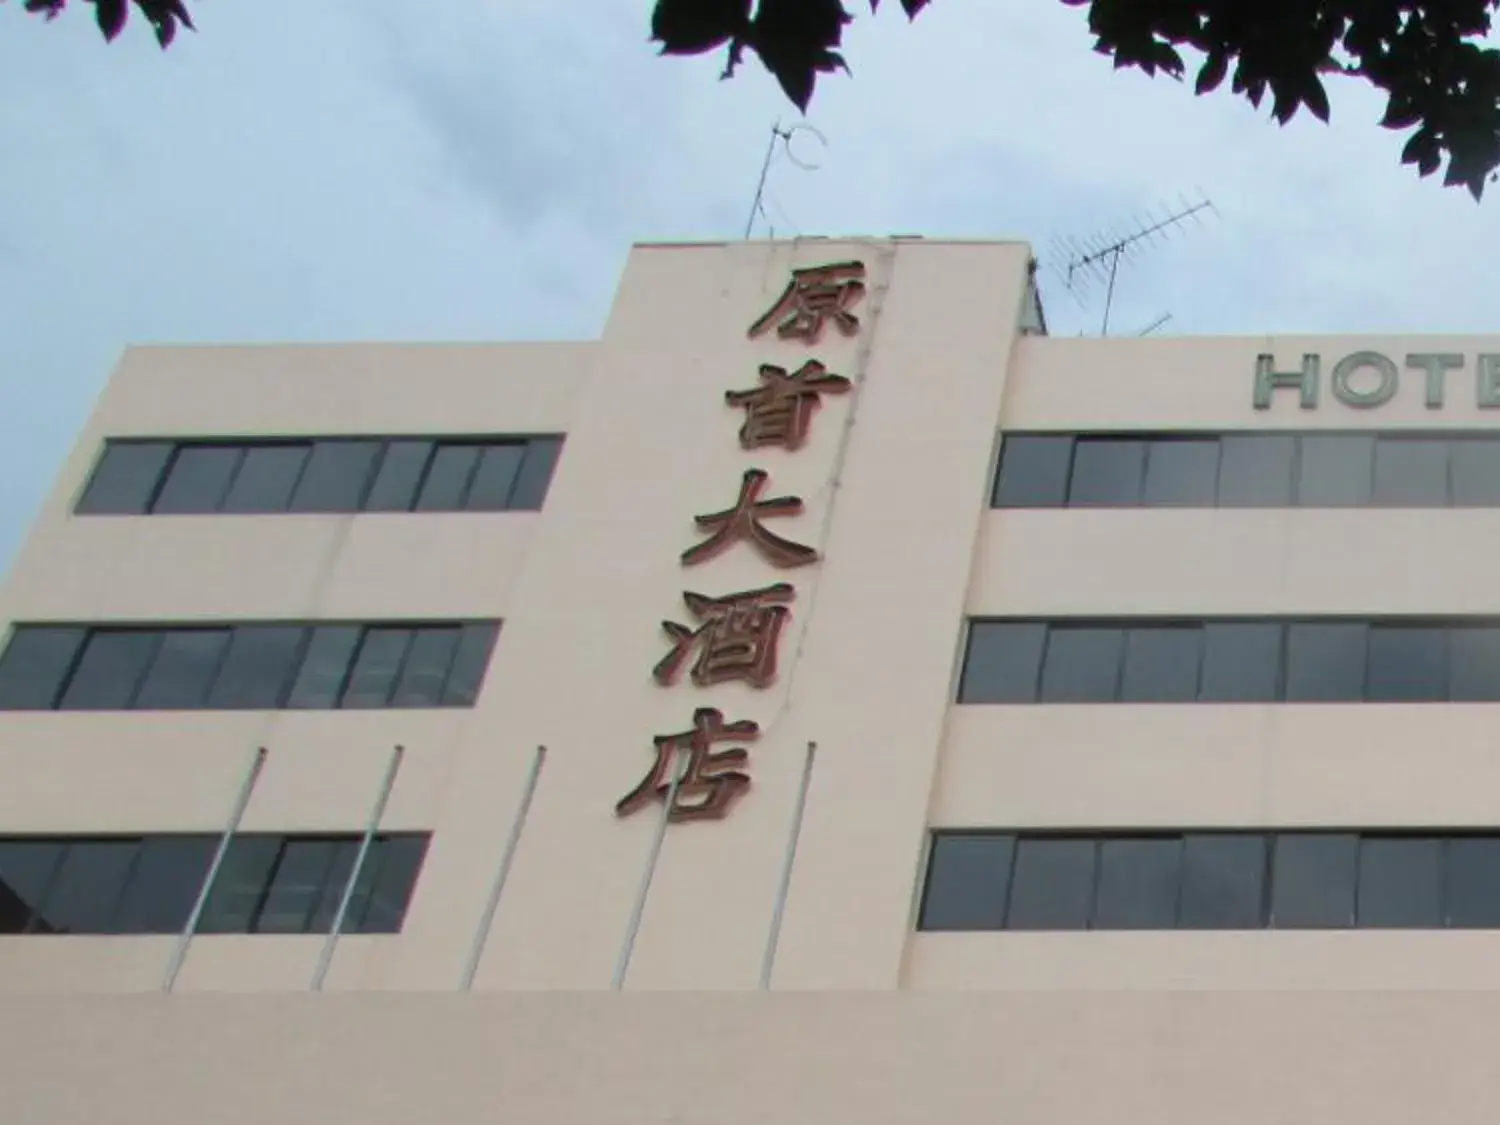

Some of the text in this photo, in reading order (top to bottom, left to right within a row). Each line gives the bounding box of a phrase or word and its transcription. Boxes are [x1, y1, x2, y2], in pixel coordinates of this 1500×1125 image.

[615, 260, 866, 822] 原首大酒店
